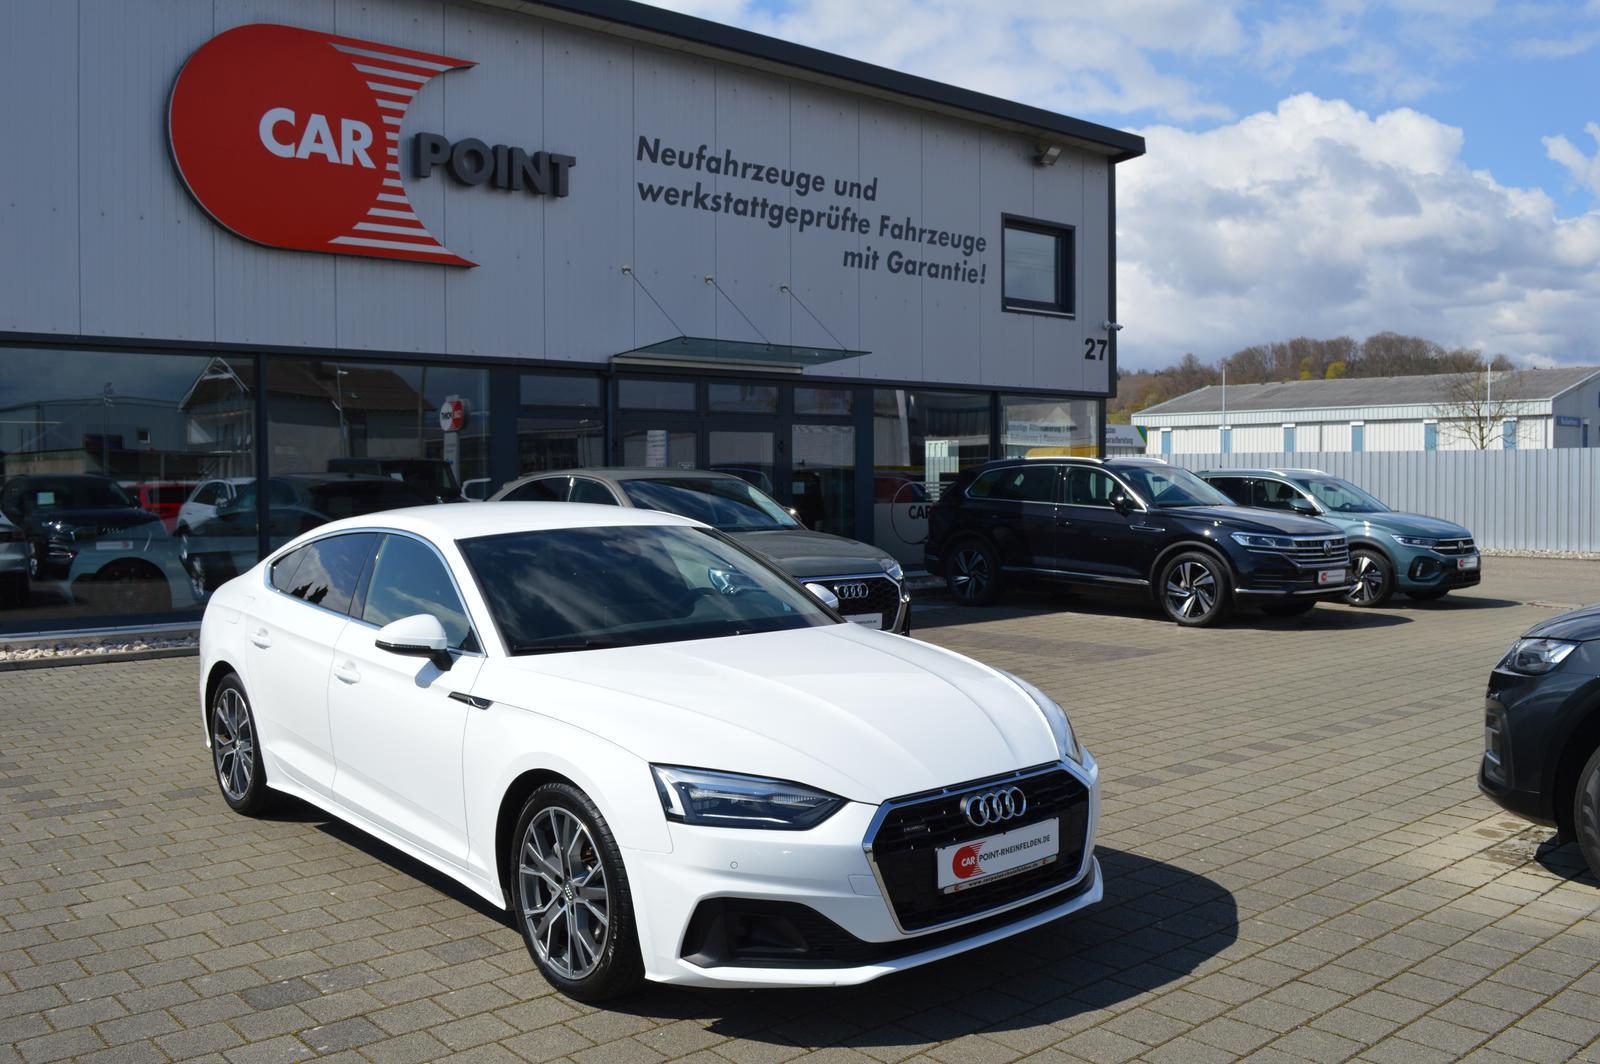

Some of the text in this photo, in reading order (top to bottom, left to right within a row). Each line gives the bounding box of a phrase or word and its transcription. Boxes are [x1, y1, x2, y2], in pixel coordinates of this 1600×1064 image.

[258, 106, 577, 198] CAR POINT
[636, 135, 878, 201] Neufahrzeuge und
[637, 181, 987, 257] werkstattgeprüfte Fahrzeuge
[843, 246, 988, 284] mit Garantie!
[1084, 337, 1108, 361] 27
[961, 834, 1051, 867] CAR POINT-RHEINFELDEN.DE
